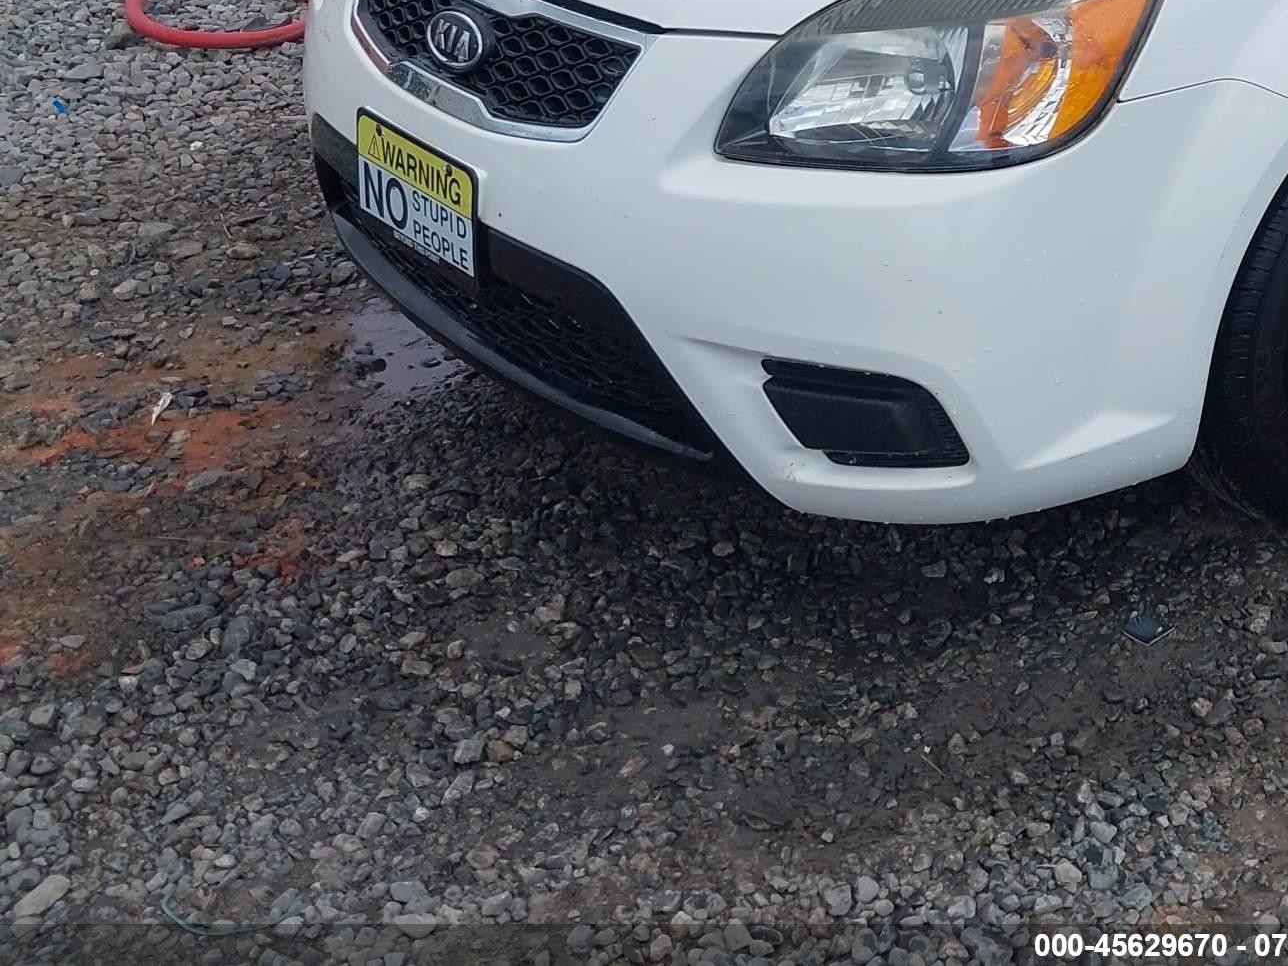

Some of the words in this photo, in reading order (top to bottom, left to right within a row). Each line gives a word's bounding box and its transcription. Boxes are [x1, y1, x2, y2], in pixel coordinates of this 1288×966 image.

[434, 18, 471, 62] KIA
[363, 161, 409, 230] NO
[412, 190, 467, 239] STUPID
[381, 137, 462, 207] WARNING
[413, 220, 470, 271] PEOPLE
